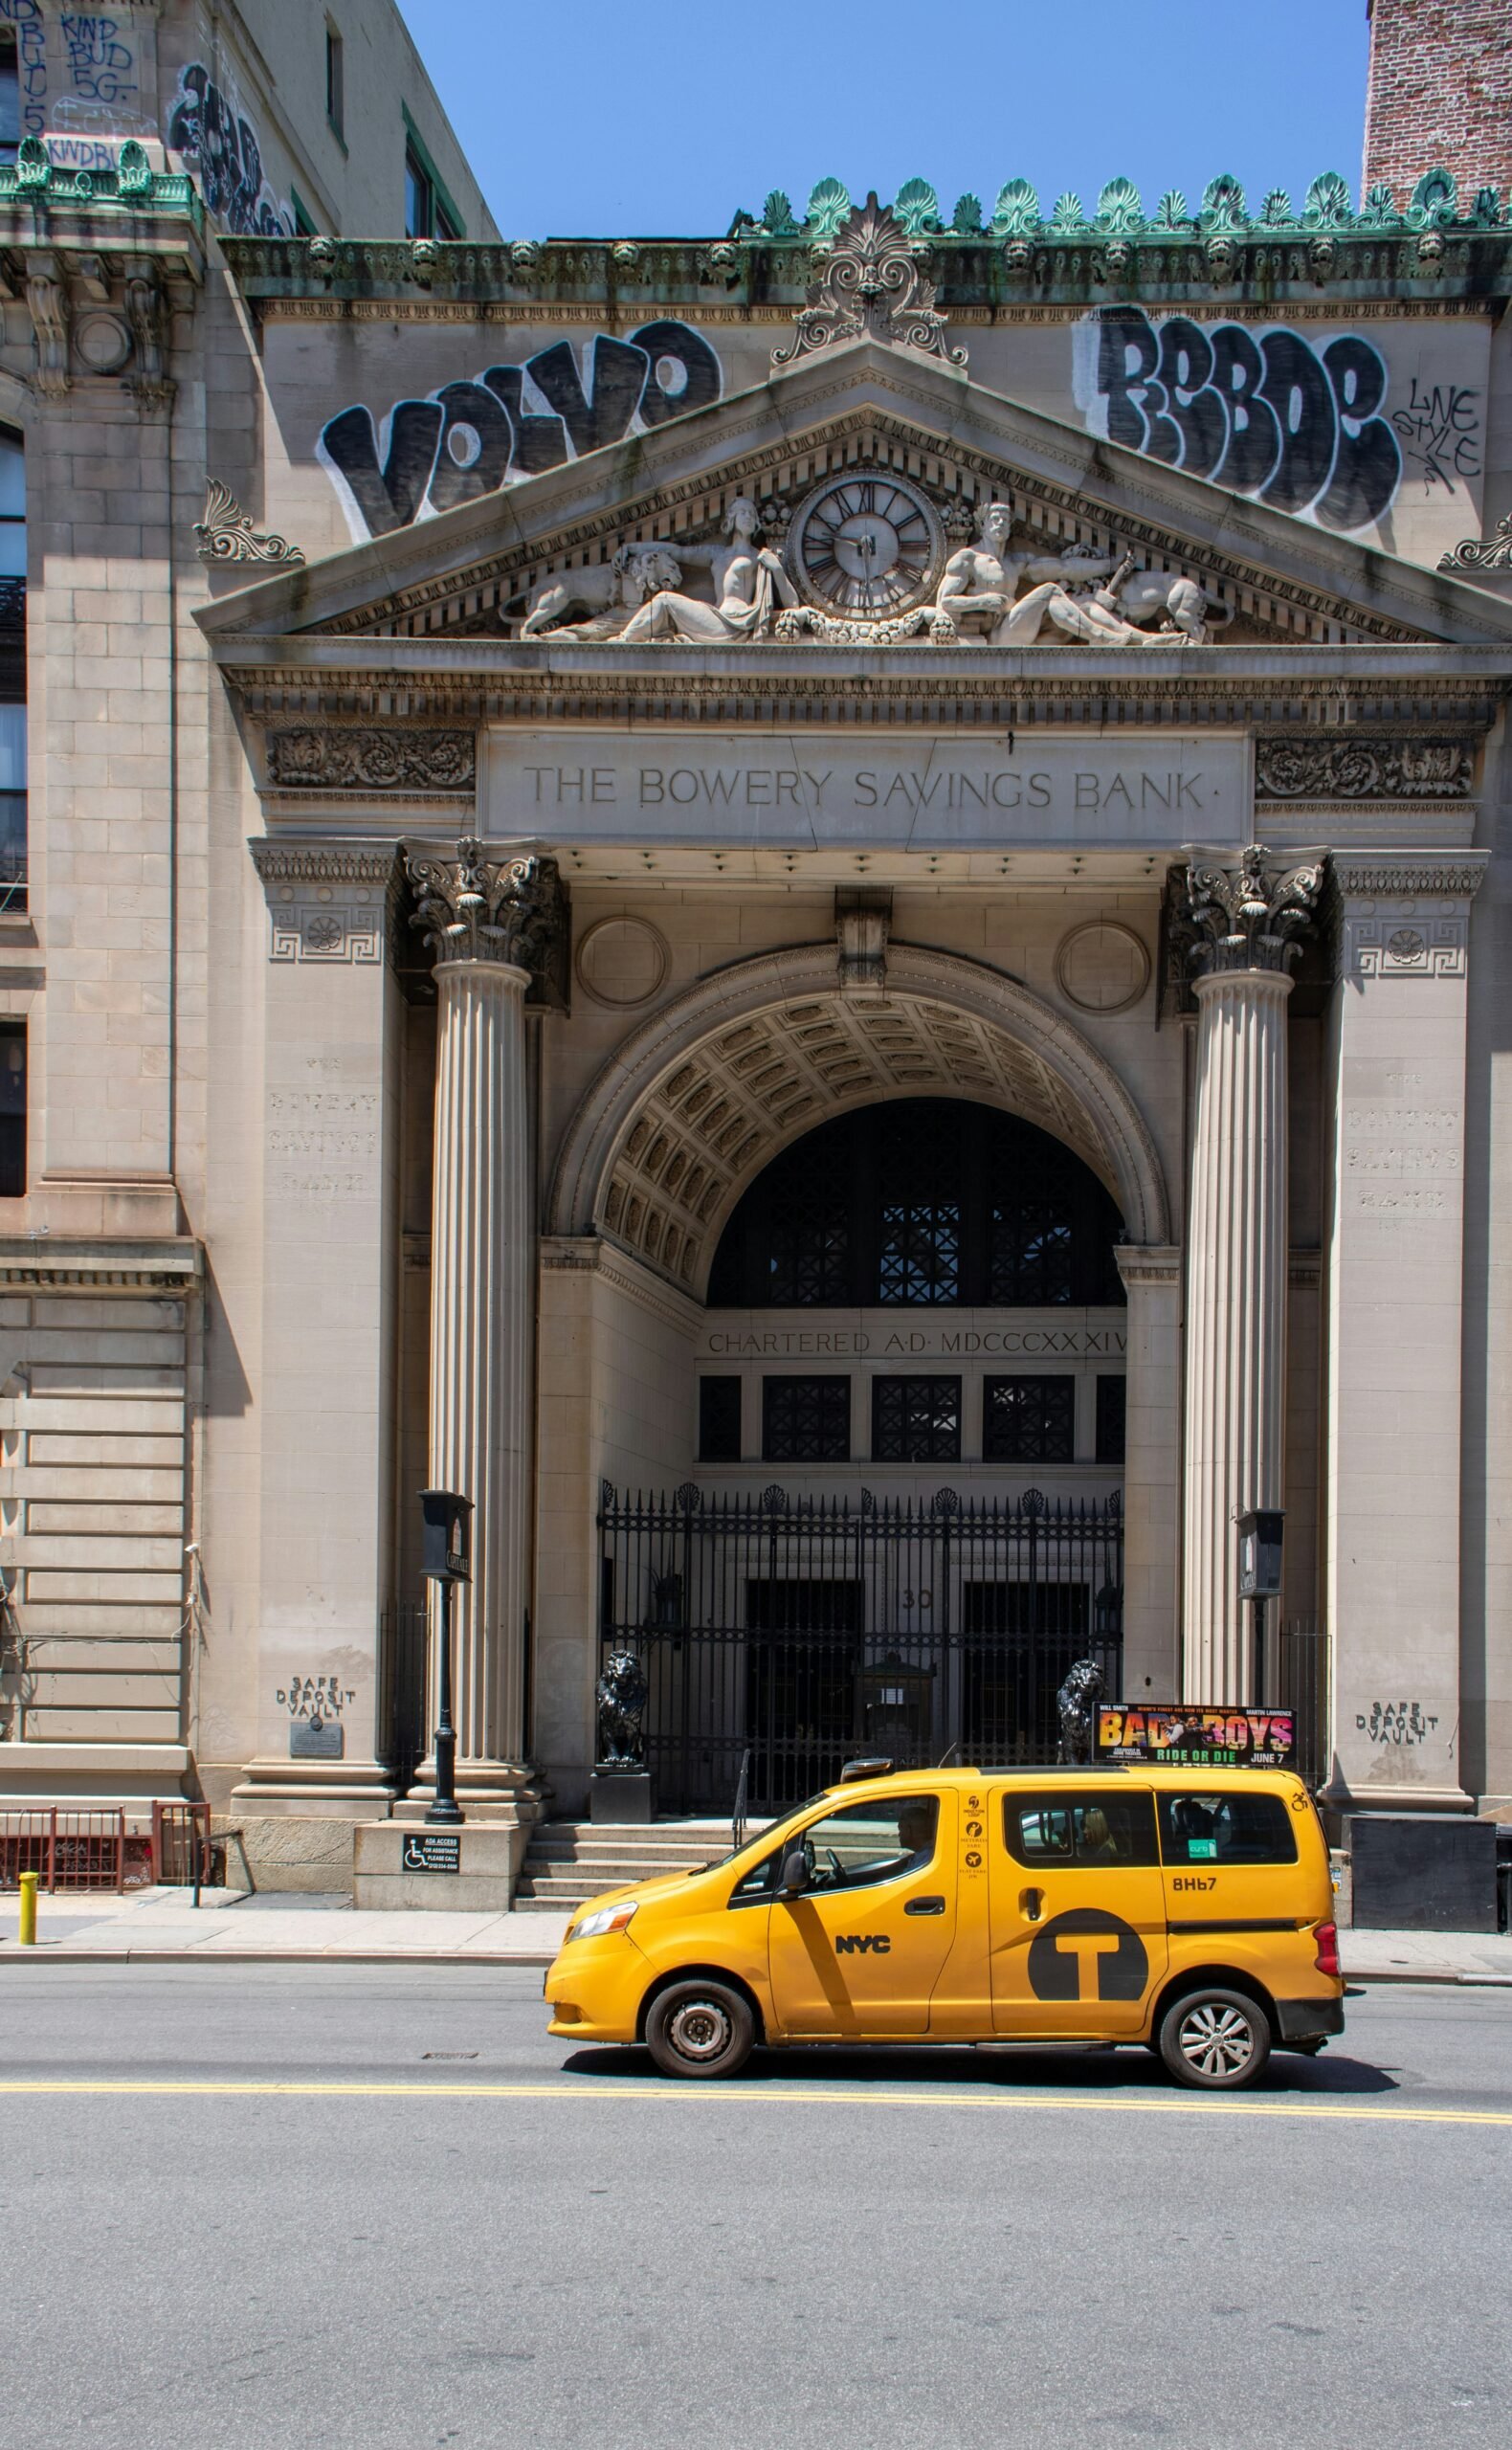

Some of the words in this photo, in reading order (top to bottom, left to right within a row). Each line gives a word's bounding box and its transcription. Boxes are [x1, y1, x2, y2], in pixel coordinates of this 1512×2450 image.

[61, 14, 118, 42] KIND
[67, 42, 132, 70] BUD
[524, 768, 615, 802] THE
[639, 769, 833, 805] BOWERY
[855, 772, 1051, 808] SAVINGS
[1075, 772, 1202, 808] BANK
[709, 1333, 870, 1352] CHARTERED
[902, 1590, 932, 1610] 30
[292, 1677, 339, 1691] SAFE
[276, 1690, 355, 1704] DEPOSIT
[288, 1704, 343, 1718] VAULT
[1372, 1702, 1420, 1717] SAFE
[1355, 1715, 1438, 1730] DEPOSIT
[1100, 1712, 1170, 1748] BAD
[1203, 1715, 1292, 1751] BOYS
[1367, 1728, 1425, 1745] VAULT
[1157, 1749, 1187, 1760] RIDE
[1192, 1750, 1209, 1761] OR
[1214, 1751, 1236, 1762] DIE
[1251, 1753, 1274, 1763] JUNE
[1278, 1754, 1284, 1763] 7
[835, 1935, 891, 1954] NYC
